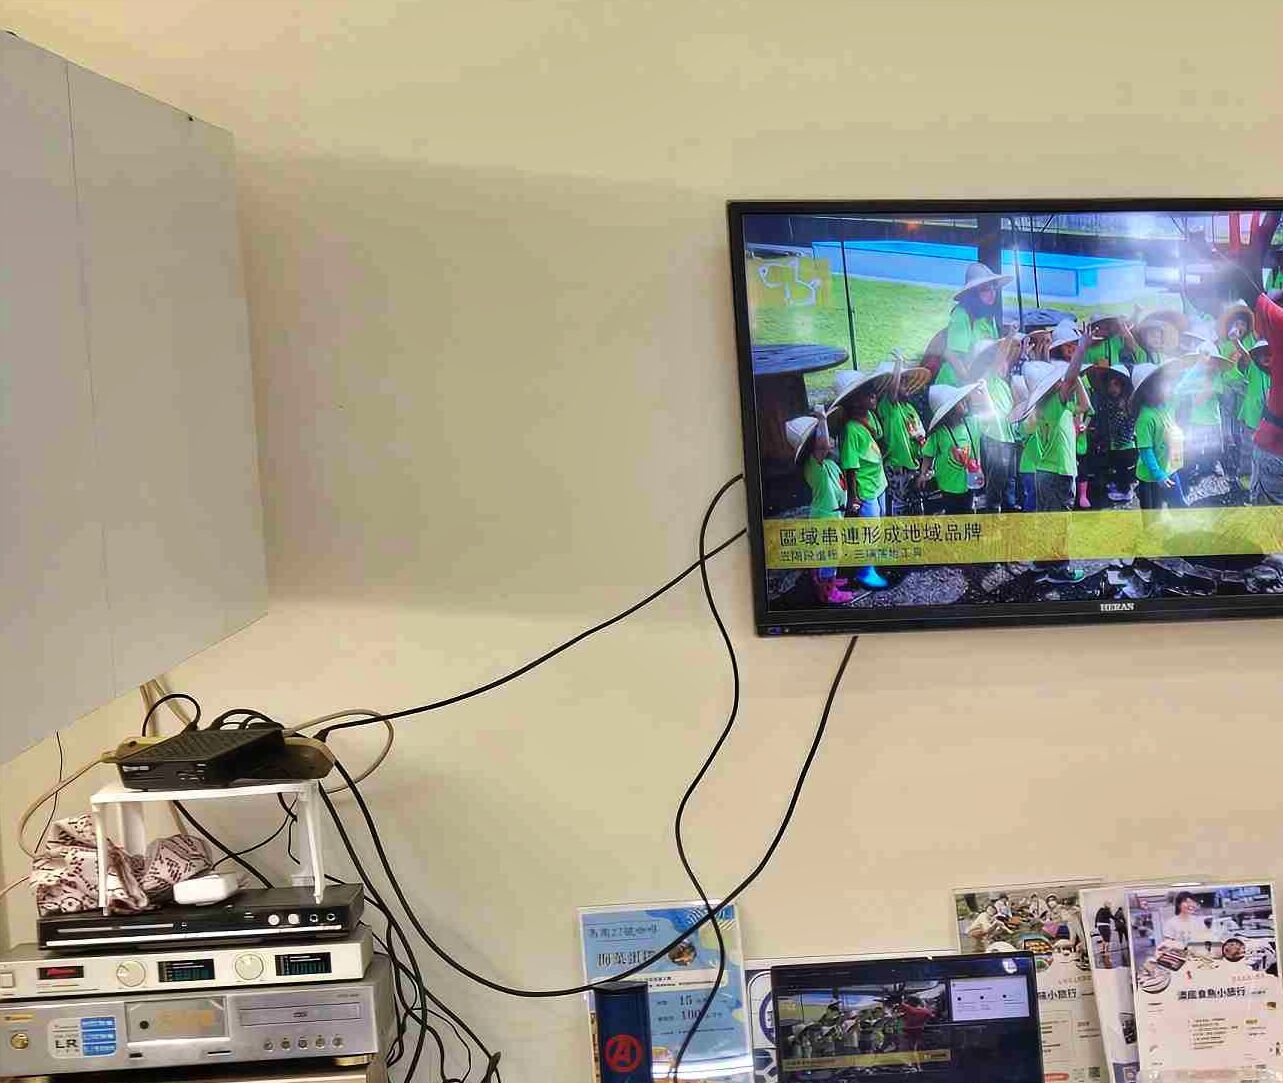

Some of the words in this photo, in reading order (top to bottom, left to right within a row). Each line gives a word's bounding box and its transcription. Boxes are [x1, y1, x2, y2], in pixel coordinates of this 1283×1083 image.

[779, 522, 983, 547] 區域串連形成地域品牌
